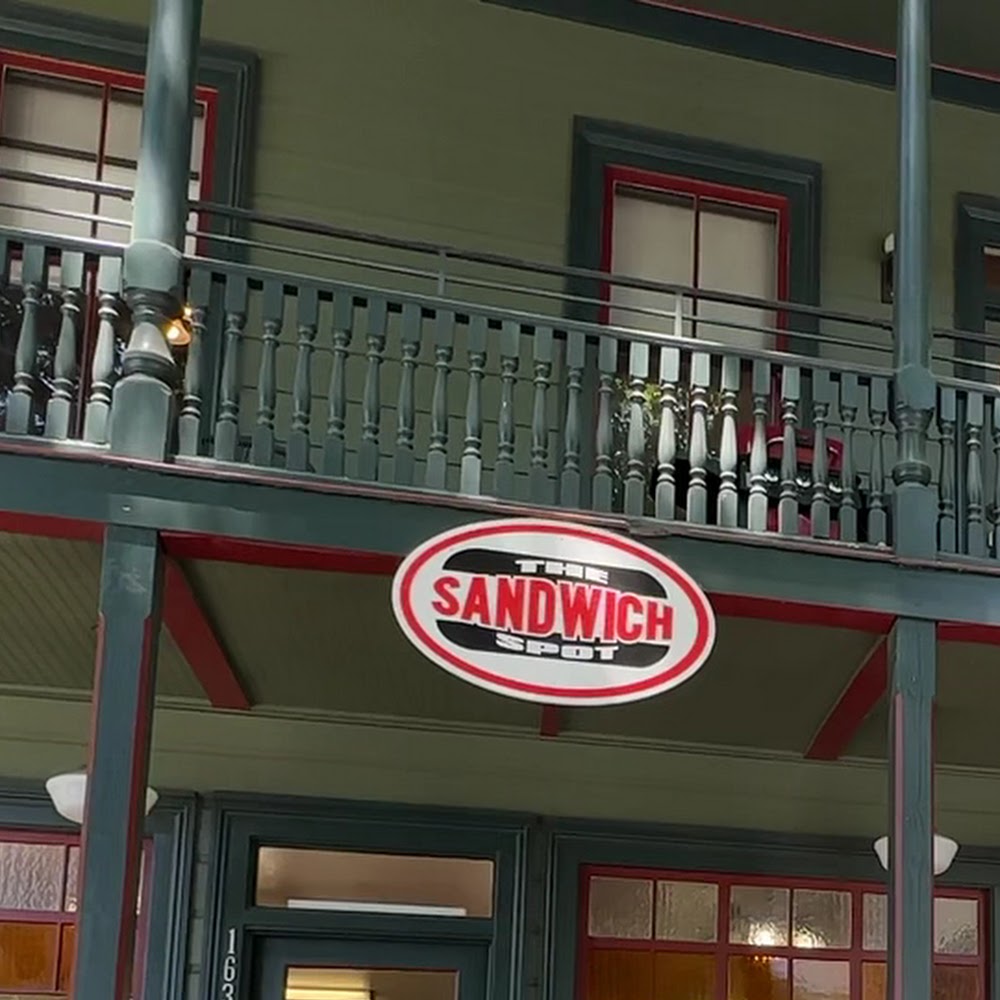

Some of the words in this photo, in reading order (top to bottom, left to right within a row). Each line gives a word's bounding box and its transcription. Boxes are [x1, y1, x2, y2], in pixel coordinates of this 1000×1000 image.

[514, 558, 609, 585] THE
[432, 574, 674, 642] SANDWICH
[495, 632, 619, 661] SPOT
